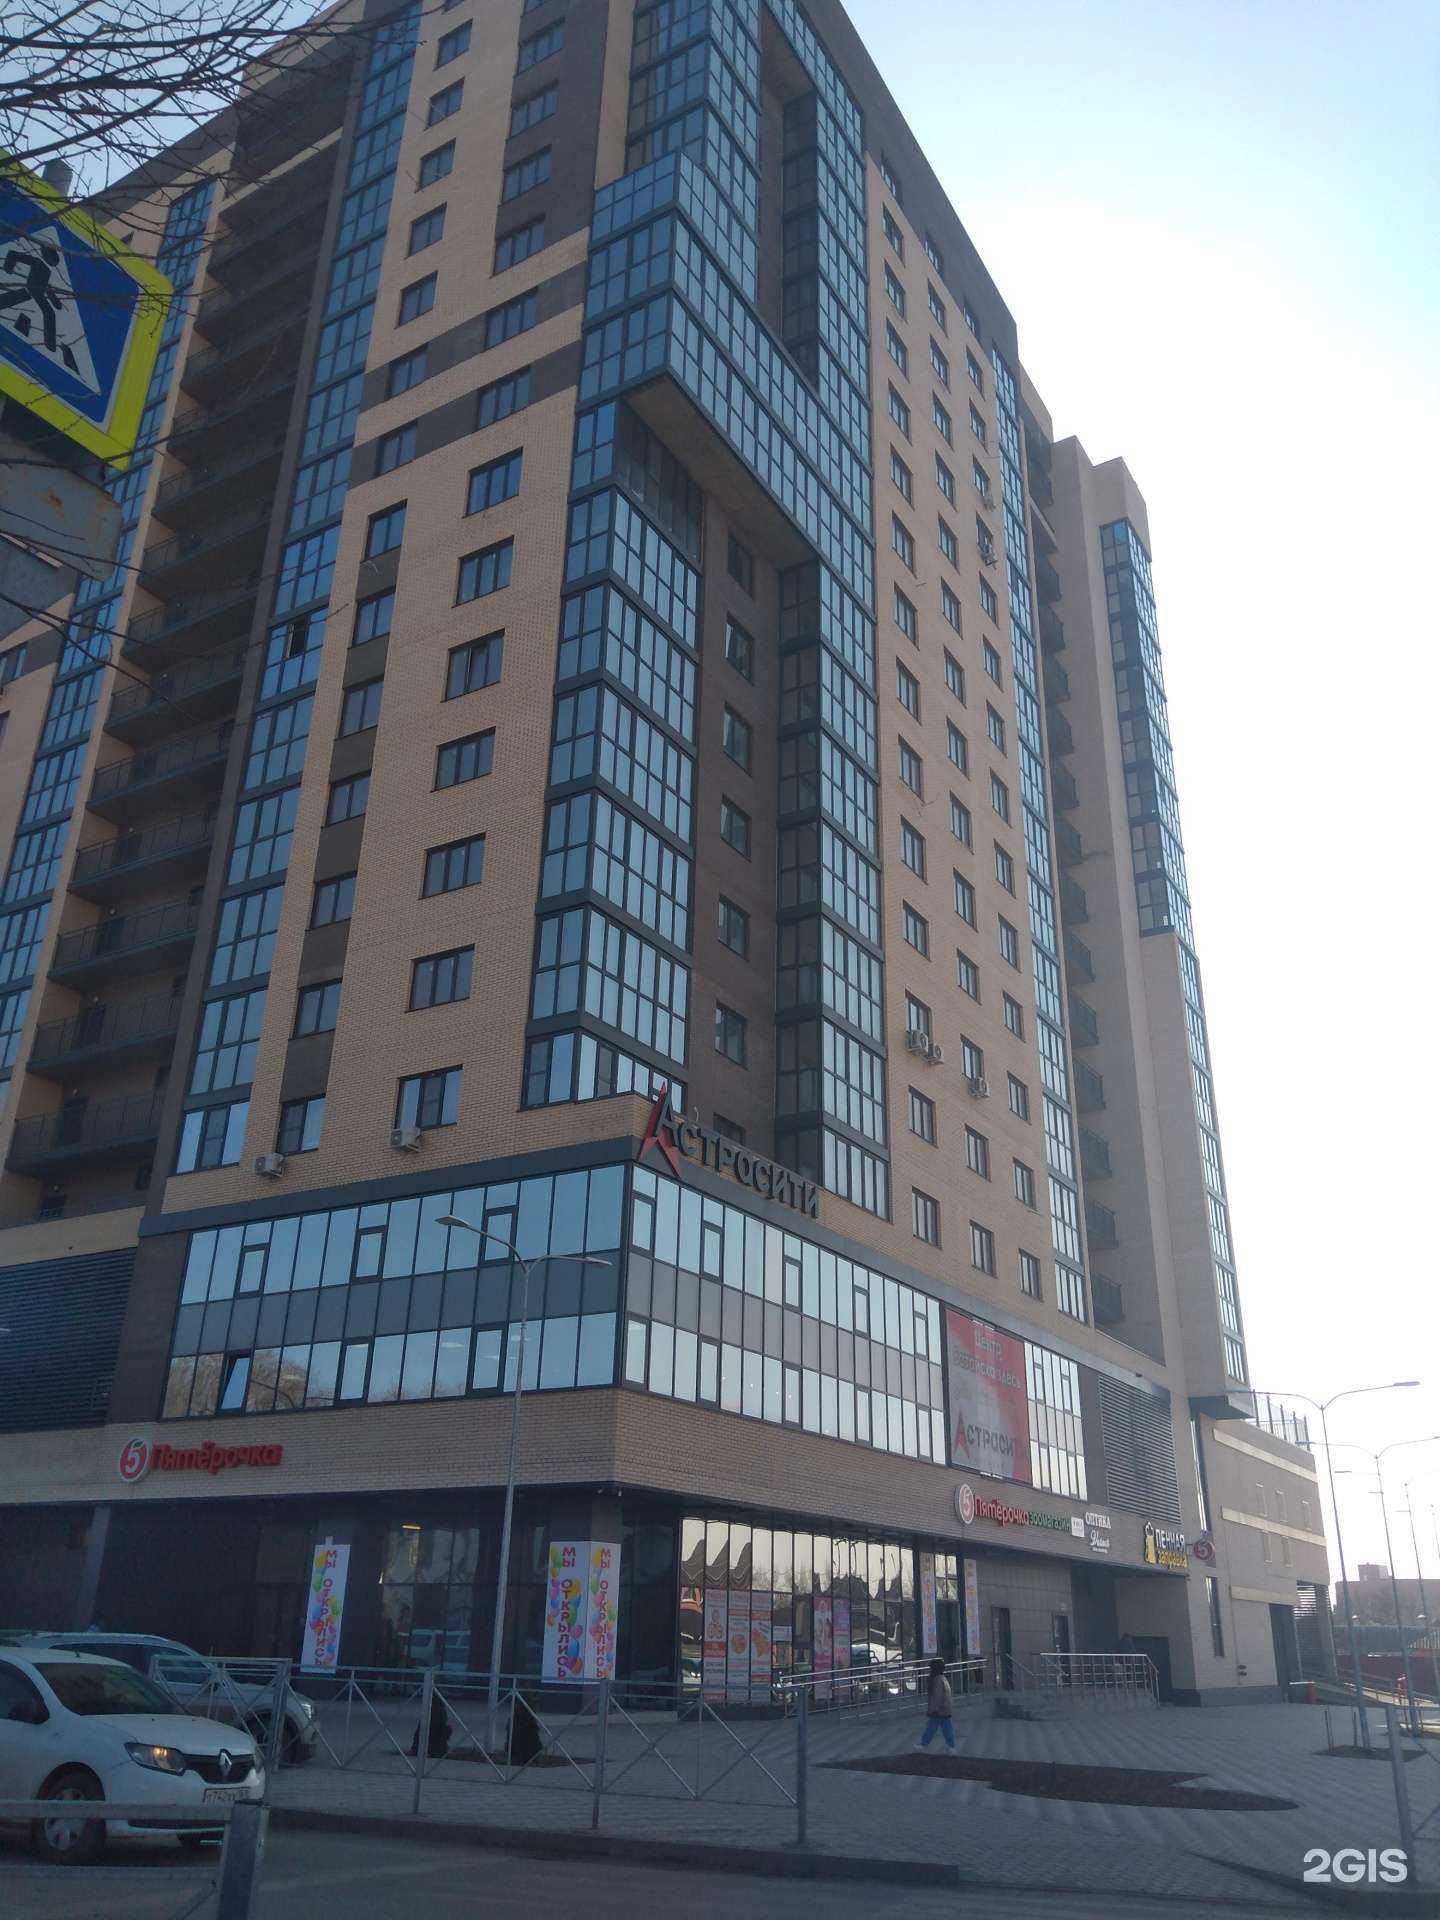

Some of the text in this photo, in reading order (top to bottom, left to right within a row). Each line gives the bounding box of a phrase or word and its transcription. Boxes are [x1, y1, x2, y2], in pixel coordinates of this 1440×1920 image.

[150, 1440, 284, 1475] Пятёрочка
[974, 1495, 1029, 1528] Пятёрочка
[557, 1546, 577, 1678] МЫ ОТКРЫЛИСЬ
